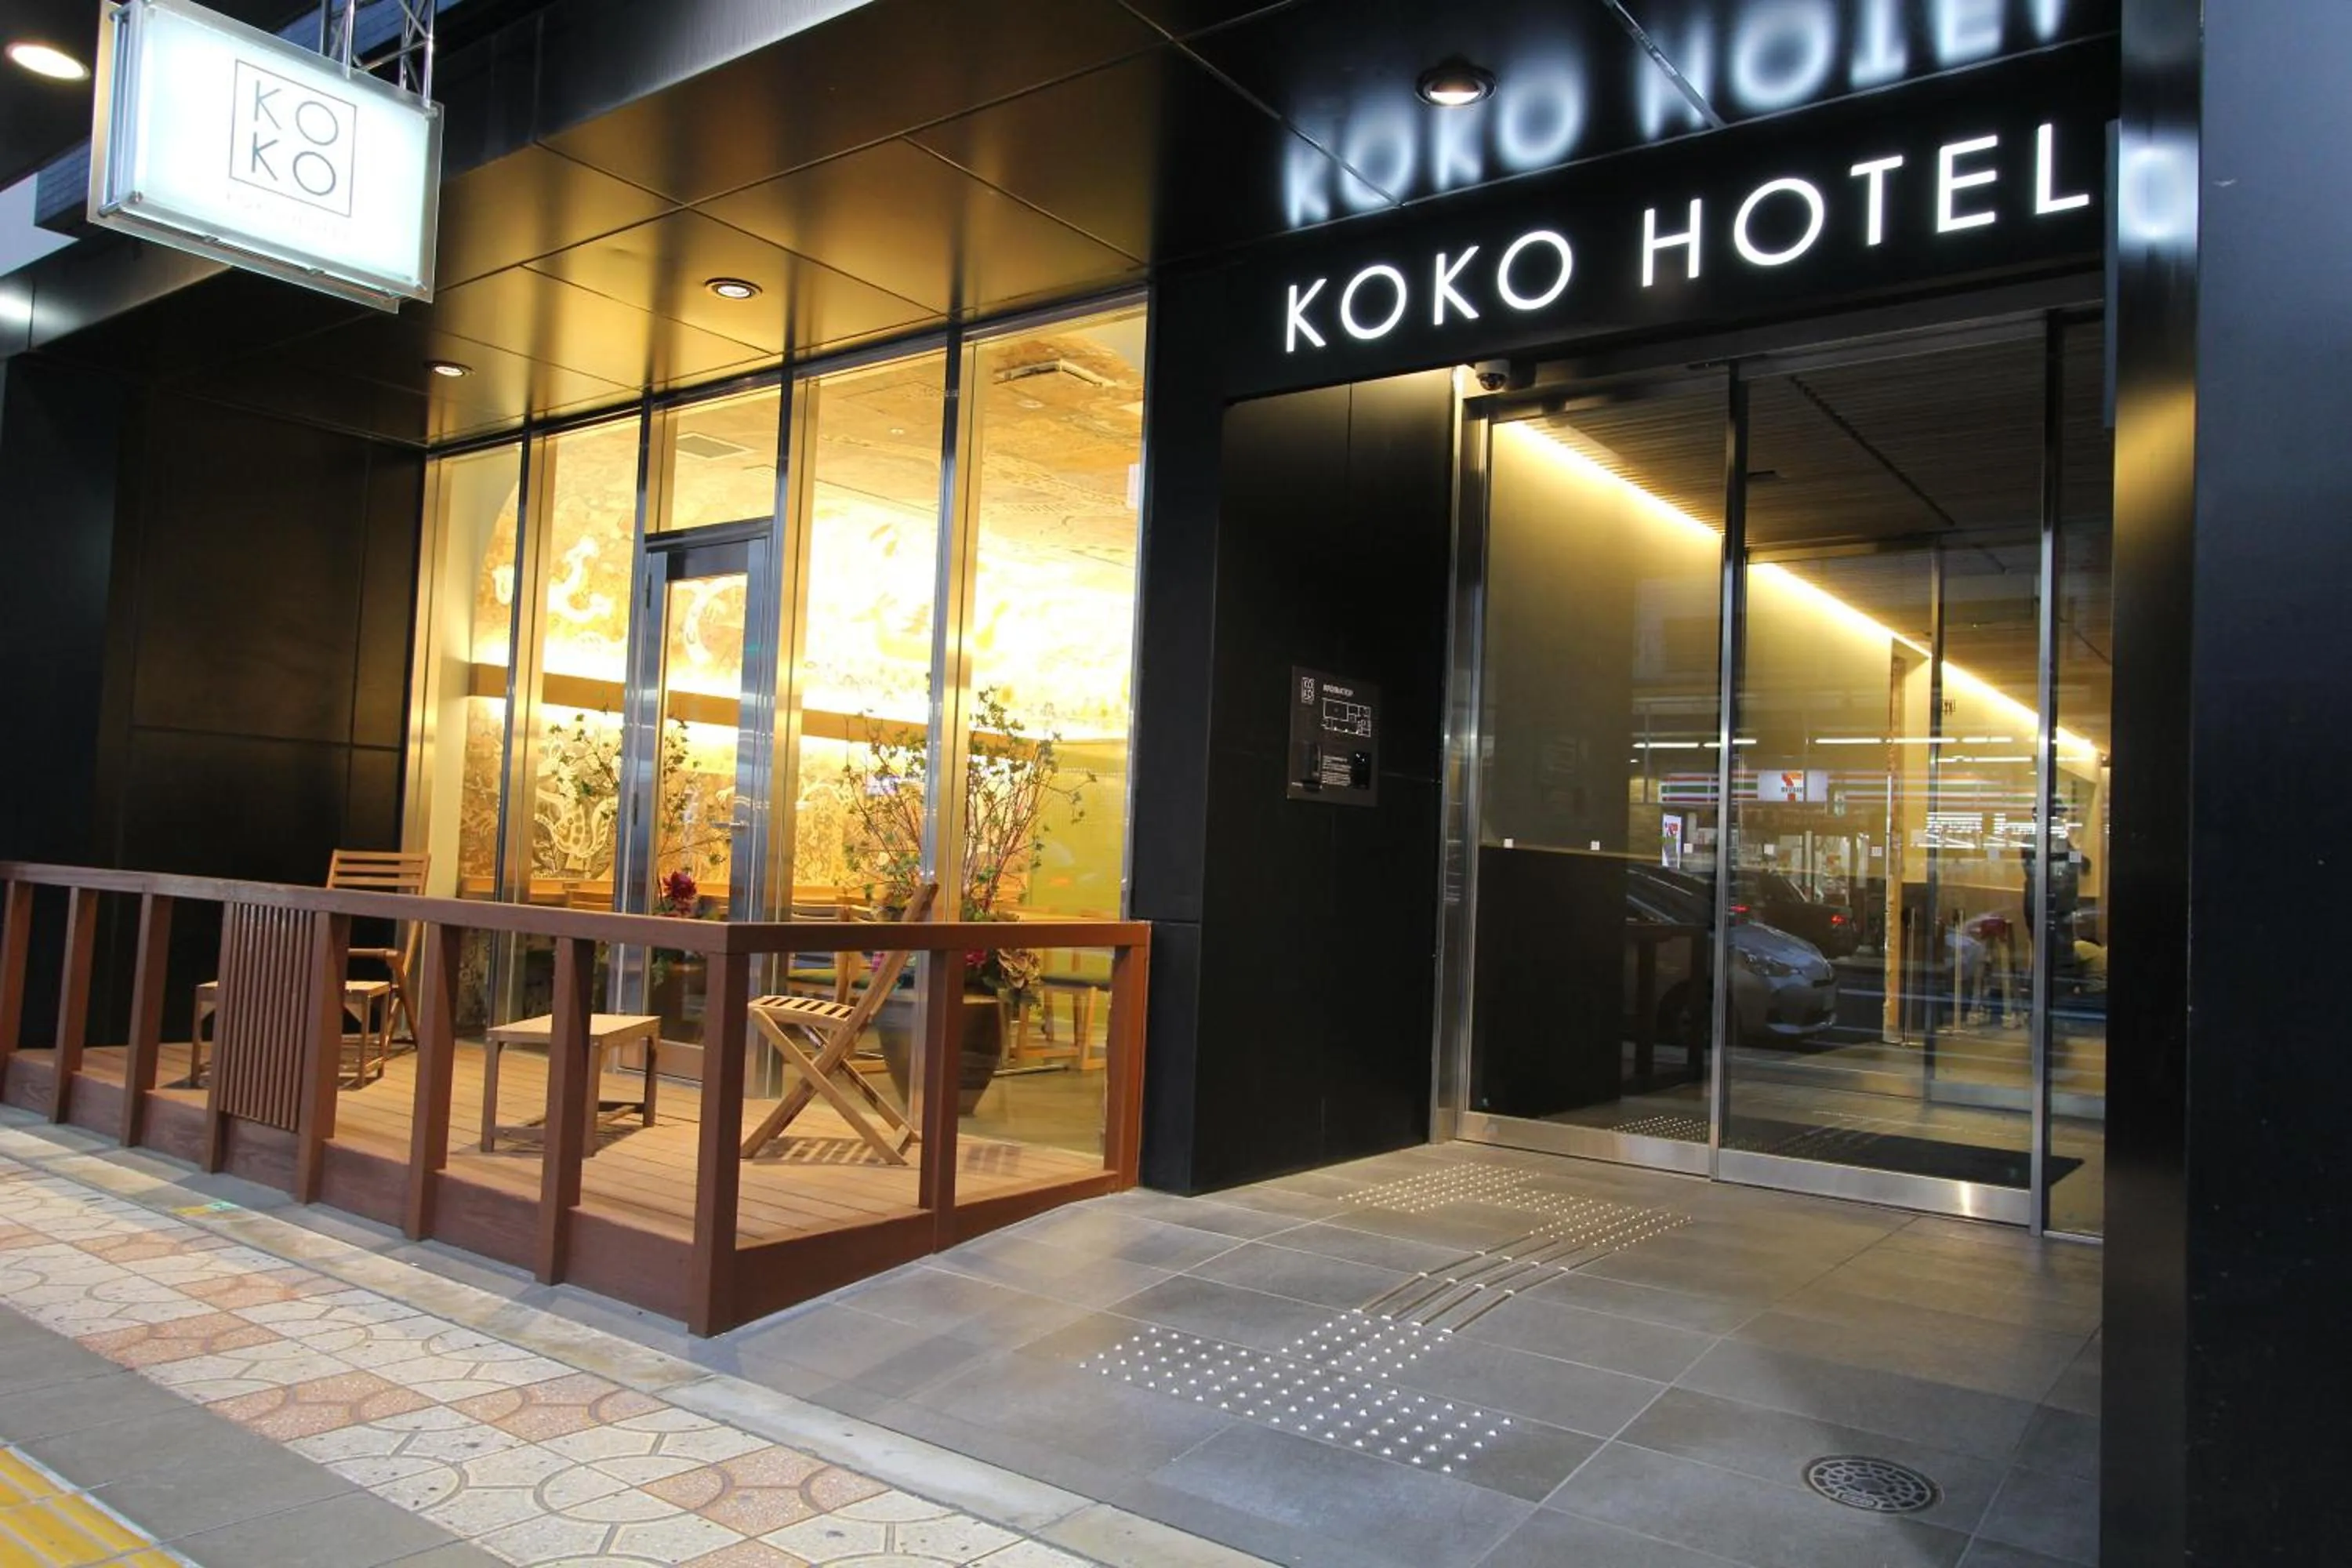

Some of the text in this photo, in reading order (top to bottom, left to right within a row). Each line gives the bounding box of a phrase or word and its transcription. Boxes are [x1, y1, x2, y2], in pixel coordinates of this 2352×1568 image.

[255, 81, 339, 147] KO
[252, 132, 336, 196] KO
[1287, 124, 2089, 352] KOKO HOTEL
